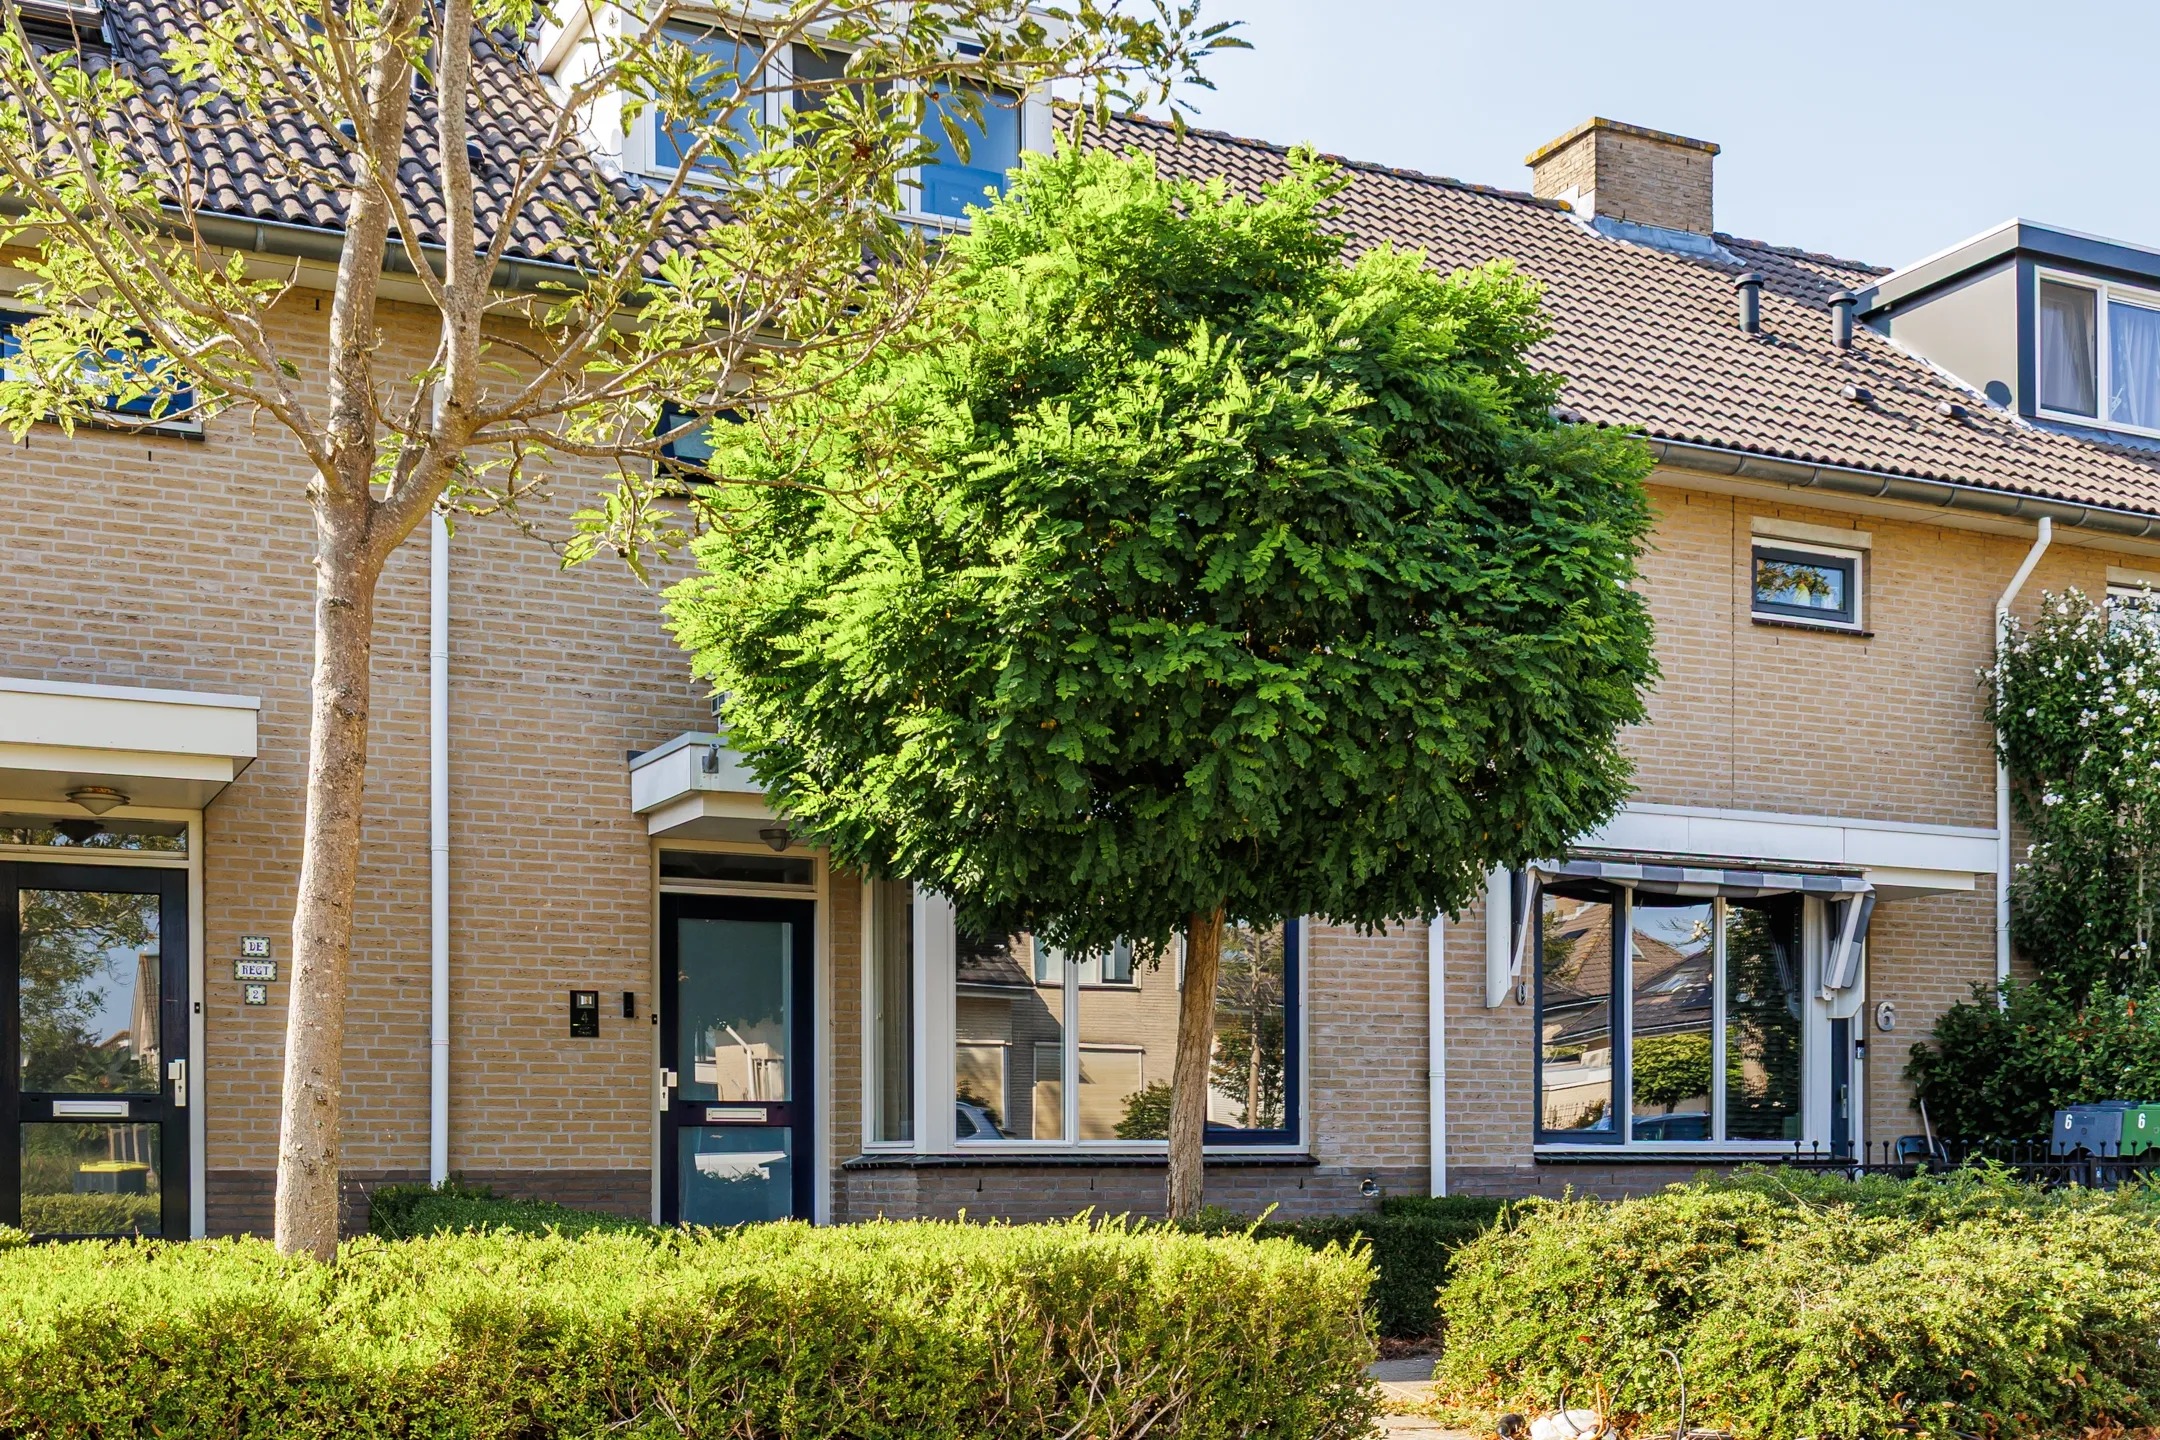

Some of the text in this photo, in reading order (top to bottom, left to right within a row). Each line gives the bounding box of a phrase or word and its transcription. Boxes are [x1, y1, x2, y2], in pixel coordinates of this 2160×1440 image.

[249, 942, 263, 951] DE
[242, 965, 269, 975] REGT
[252, 989, 259, 999] 2
[581, 1011, 588, 1023] 4
[1876, 1001, 1896, 1031] 6
[2064, 1113, 2073, 1129] 6
[2137, 1113, 2146, 1129] 6
